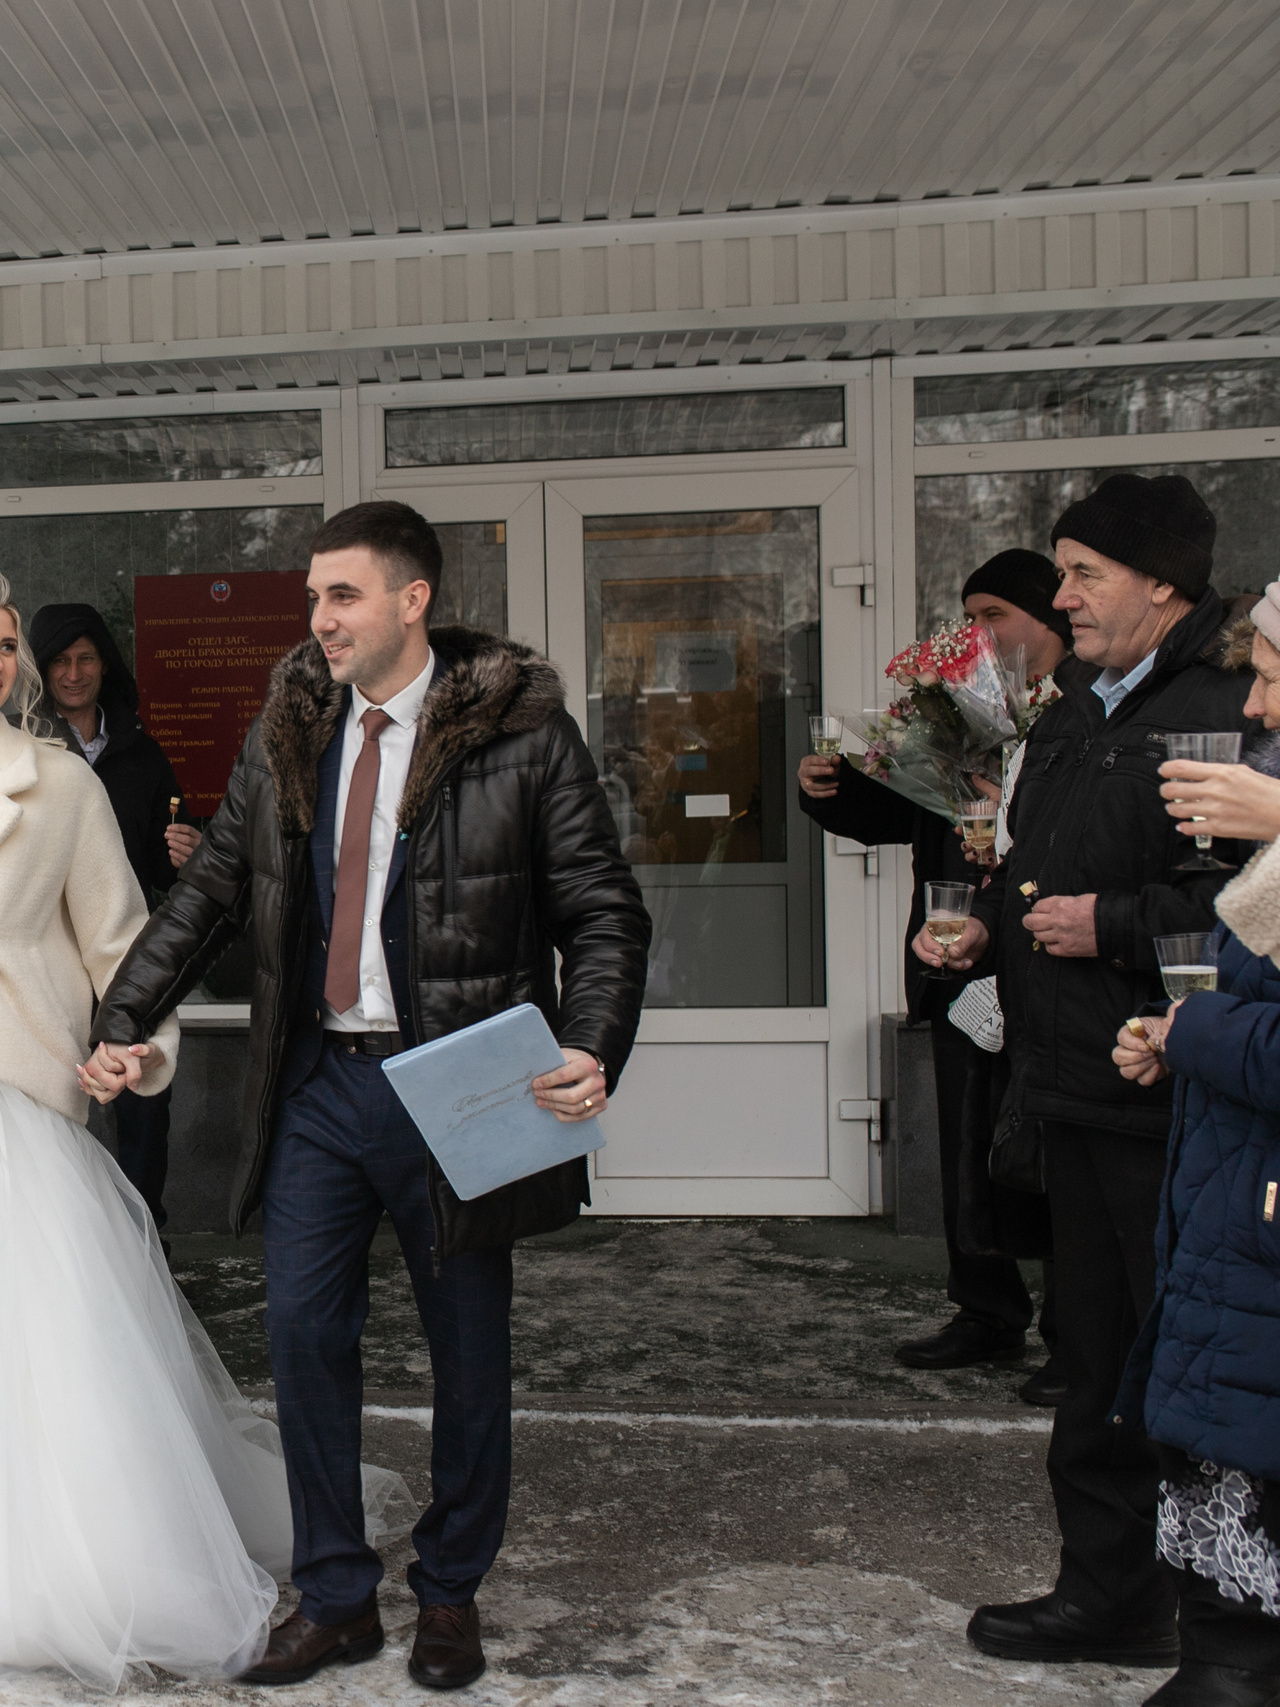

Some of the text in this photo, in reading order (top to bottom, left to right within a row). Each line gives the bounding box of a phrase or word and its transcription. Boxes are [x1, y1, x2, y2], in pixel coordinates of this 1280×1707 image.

[144, 618, 191, 626] УПРАВЛЕНИЕ
[192, 616, 230, 624] ЮСТИЦИИ
[231, 614, 279, 623] АЛТАЙСКОГО
[188, 637, 222, 646] ОТДЕЛ
[224, 636, 250, 645] ЗАГС
[154, 649, 196, 659] ДВОРЕЦ
[166, 657, 279, 669] ПО ГОРОДУ БАРНАУЛУ
[191, 685, 256, 694] РЕЖИМ РАБОТЫ:
[150, 702, 183, 711] Вторник
[188, 700, 221, 709] пятница
[177, 712, 213, 721] граждан
[150, 728, 182, 738] Суббота
[179, 739, 215, 748] граждан
